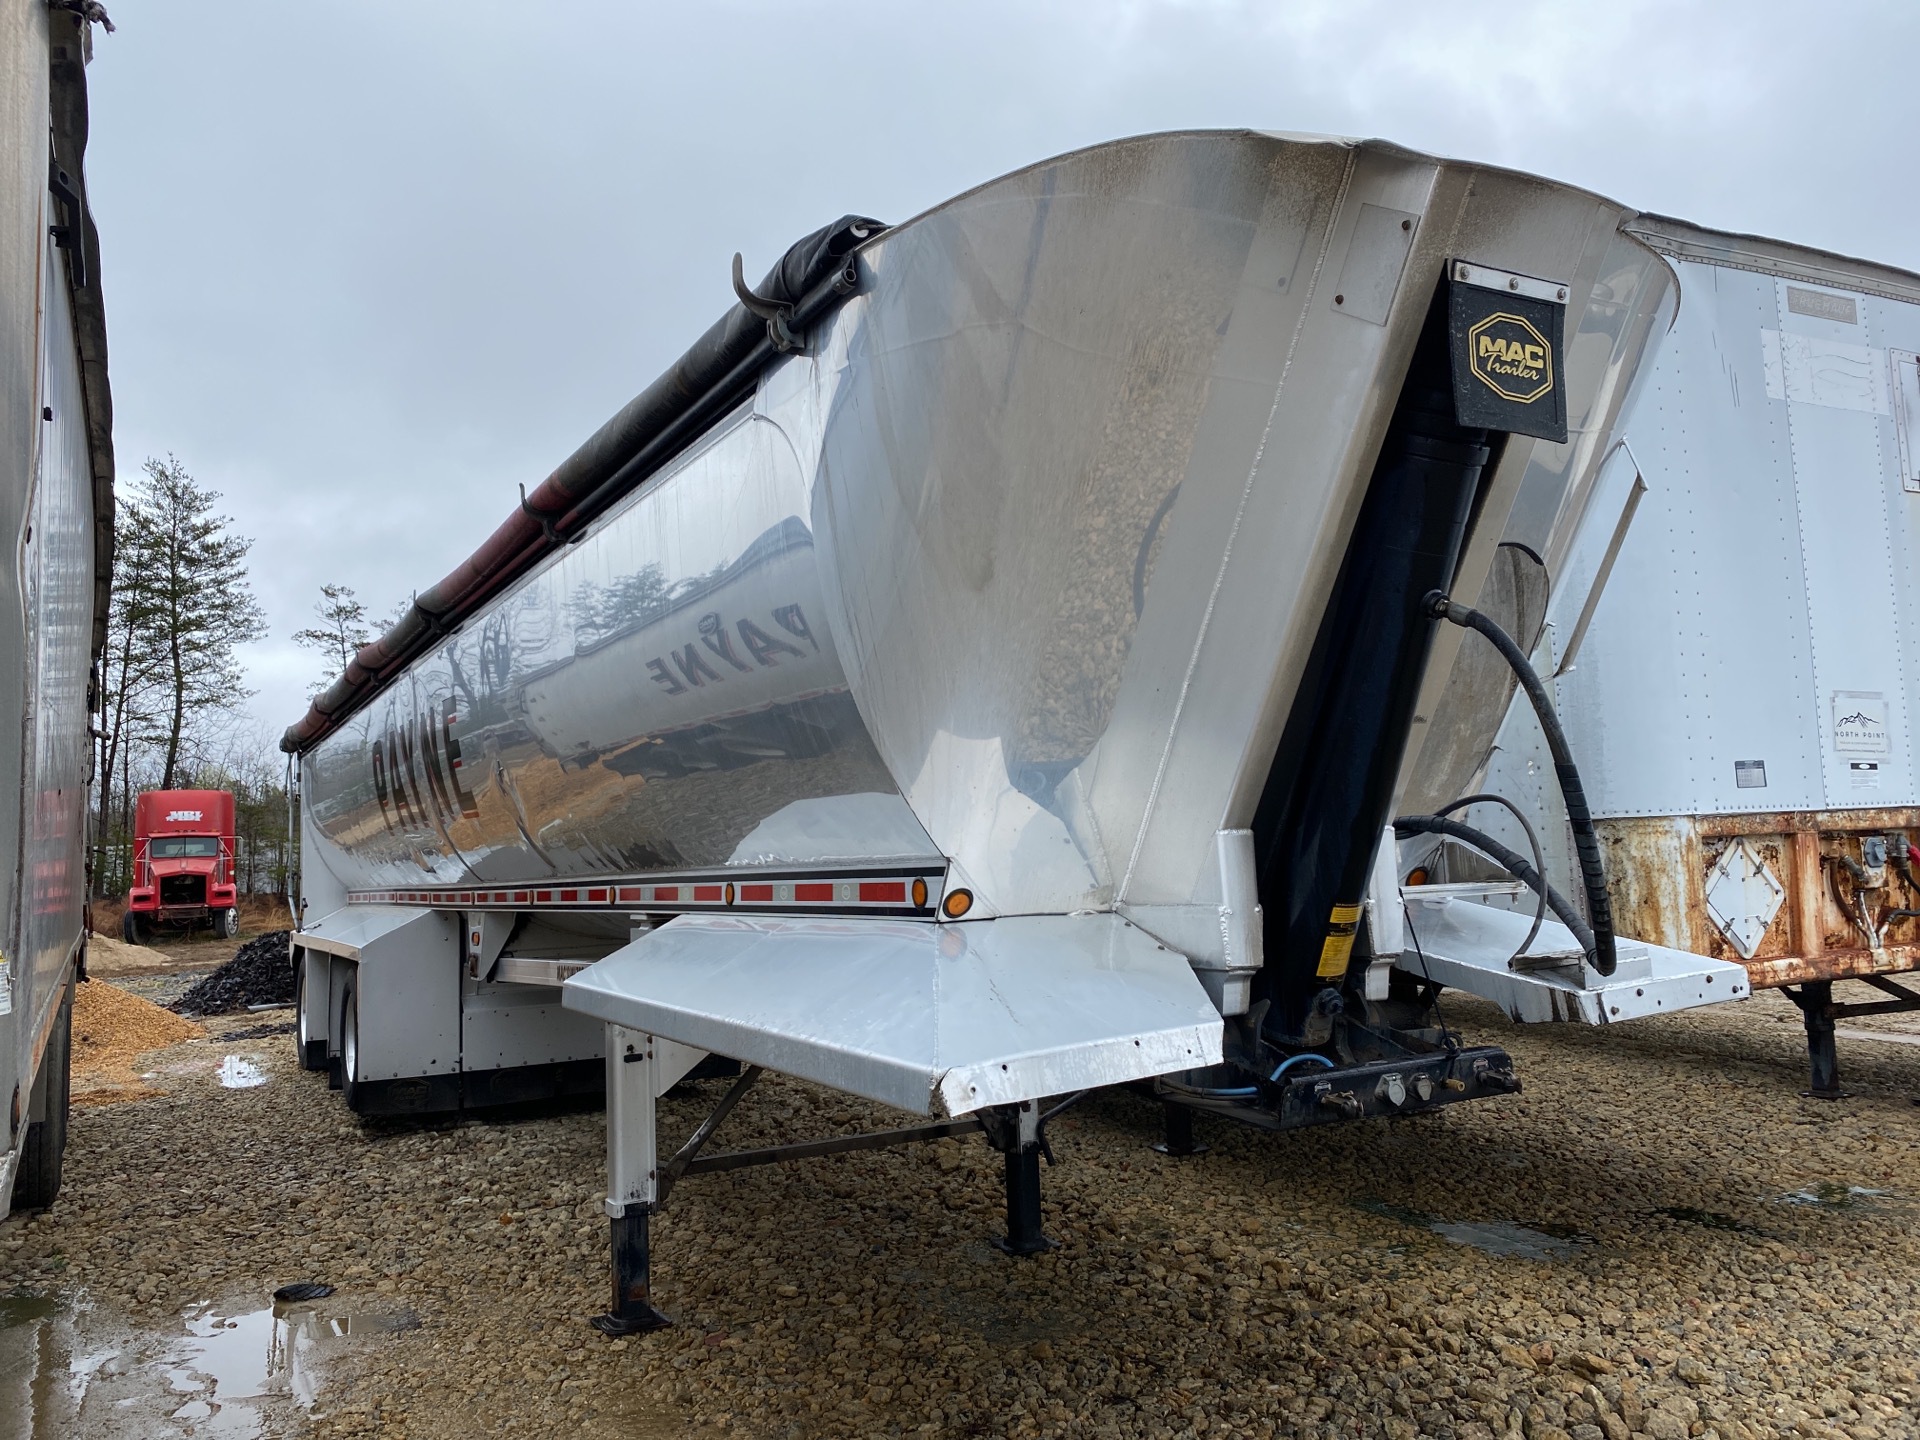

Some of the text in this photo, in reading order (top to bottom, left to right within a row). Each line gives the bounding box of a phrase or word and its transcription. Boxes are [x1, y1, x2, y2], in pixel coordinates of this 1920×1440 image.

[1479, 335, 1544, 369] MAC
[1484, 351, 1540, 380] Trailer
[372, 695, 480, 836] PAYNE
